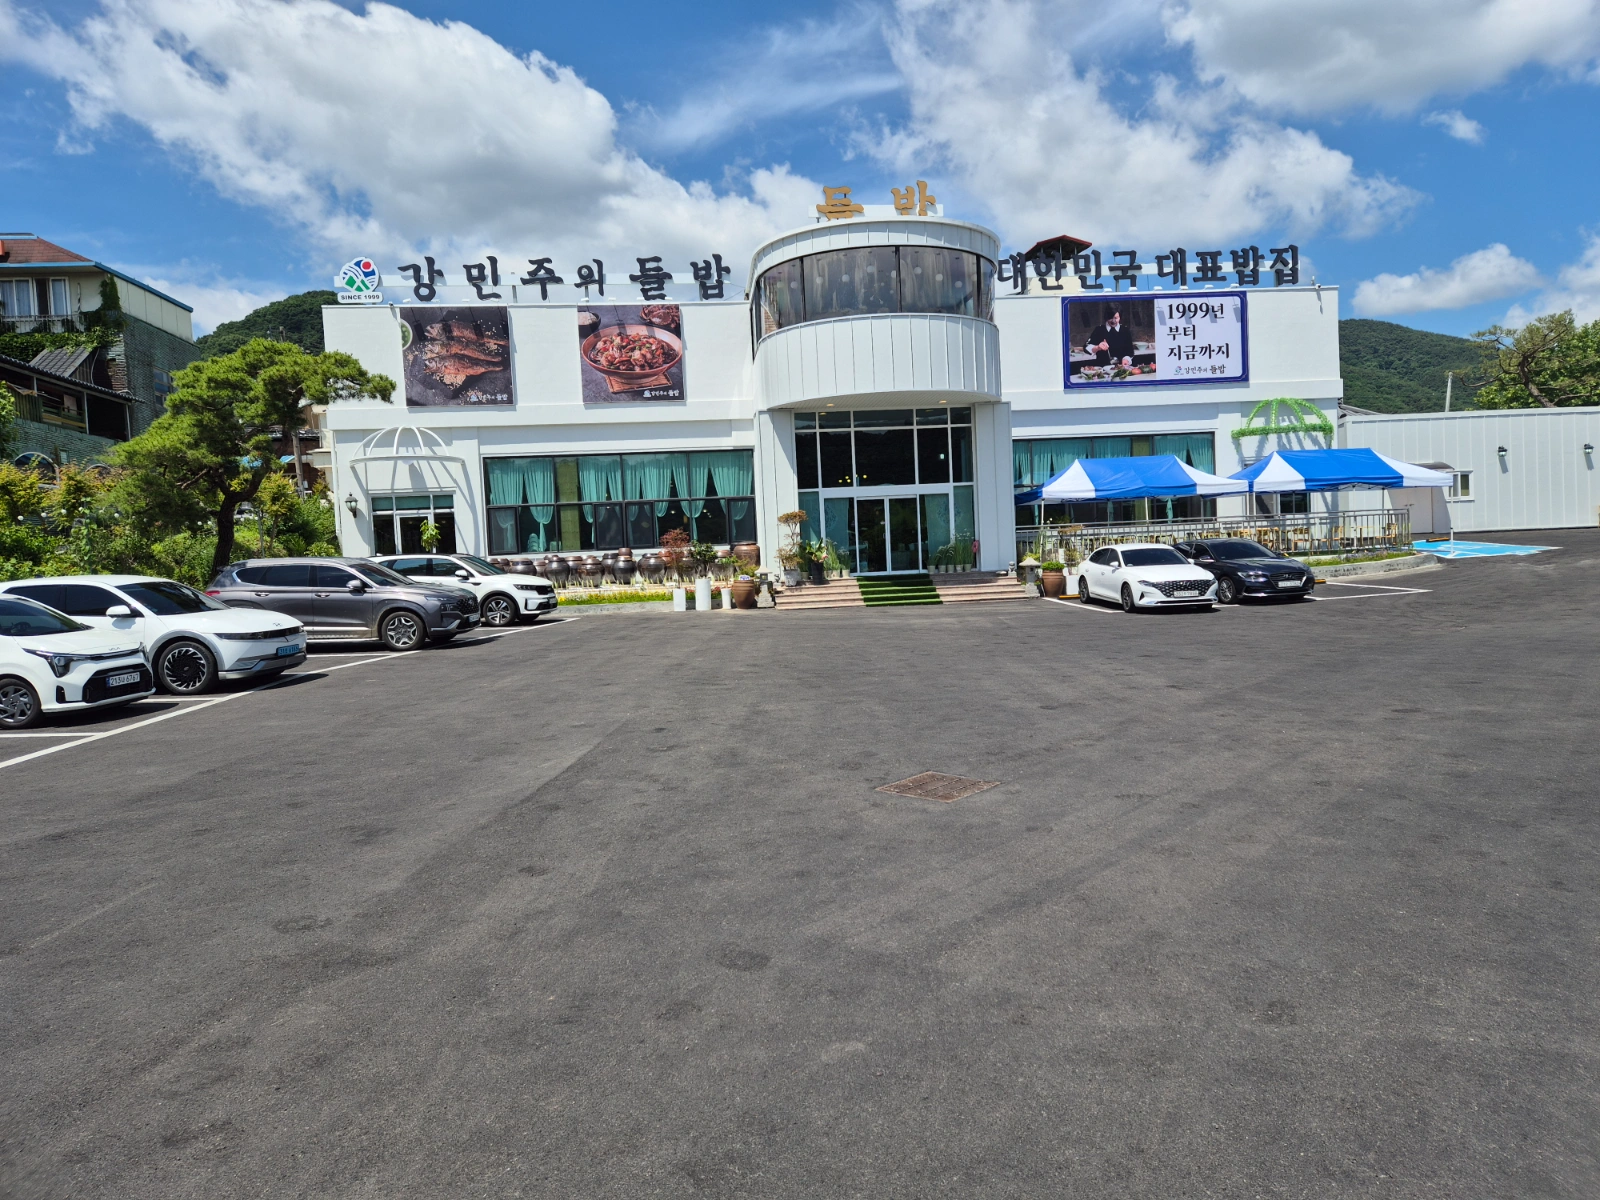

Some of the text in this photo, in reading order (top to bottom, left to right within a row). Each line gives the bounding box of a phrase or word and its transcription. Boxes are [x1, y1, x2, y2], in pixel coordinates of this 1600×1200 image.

[397, 253, 731, 302] 강민주의 들밥
[997, 244, 1299, 292] 대한민국 대표밥집
[1167, 302, 1225, 319] 1999년
[1167, 324, 1196, 341] 부터
[1167, 342, 1230, 361] 지금까지
